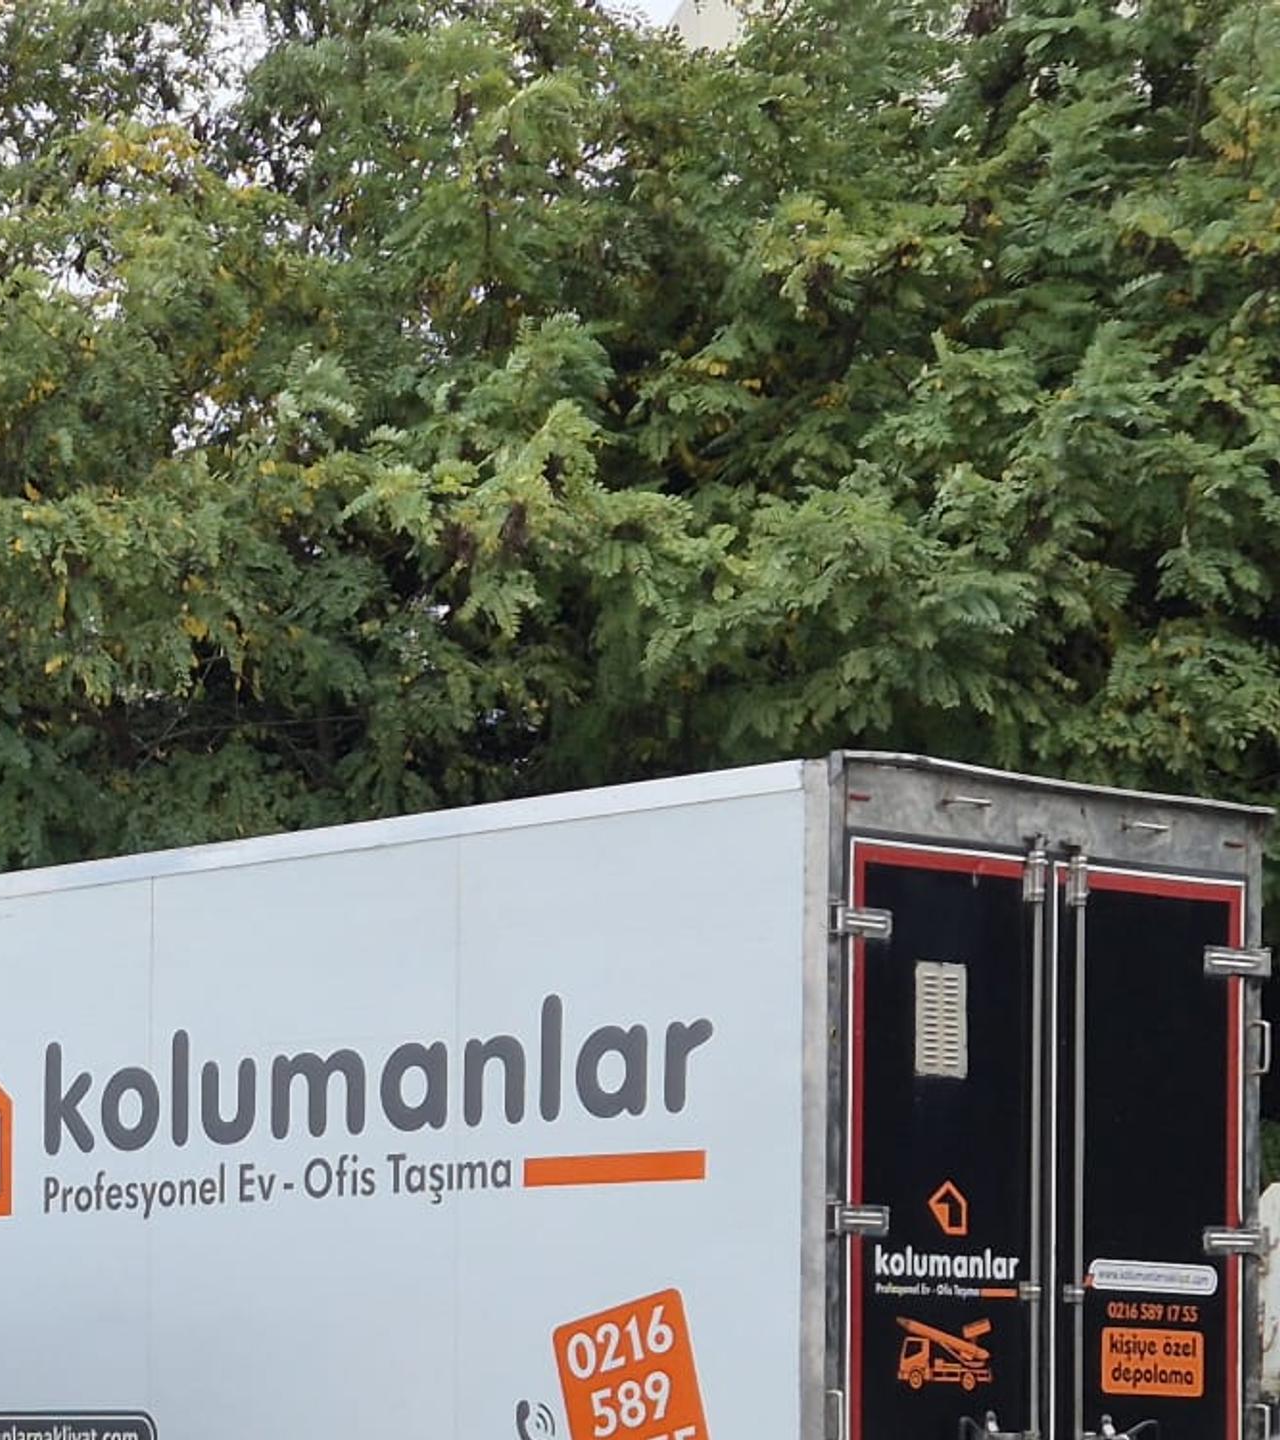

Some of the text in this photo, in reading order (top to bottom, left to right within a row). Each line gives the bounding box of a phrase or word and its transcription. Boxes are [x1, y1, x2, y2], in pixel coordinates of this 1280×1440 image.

[43, 993, 714, 1155] kolumanlar
[43, 1162, 226, 1220] Profesyonel
[239, 1163, 276, 1203] Ev
[304, 1156, 376, 1199] Ofis
[386, 1153, 512, 1204] Taşıma
[875, 1244, 1020, 1280] kolumanlar
[1108, 1302, 1138, 1319] 0216
[1167, 1305, 1179, 1321] 17
[1182, 1305, 1198, 1322] 55
[567, 1305, 674, 1379] 0216
[1109, 1333, 1197, 1361] kişiye özel
[1111, 1361, 1194, 1388] depolama
[590, 1371, 671, 1438] 589
